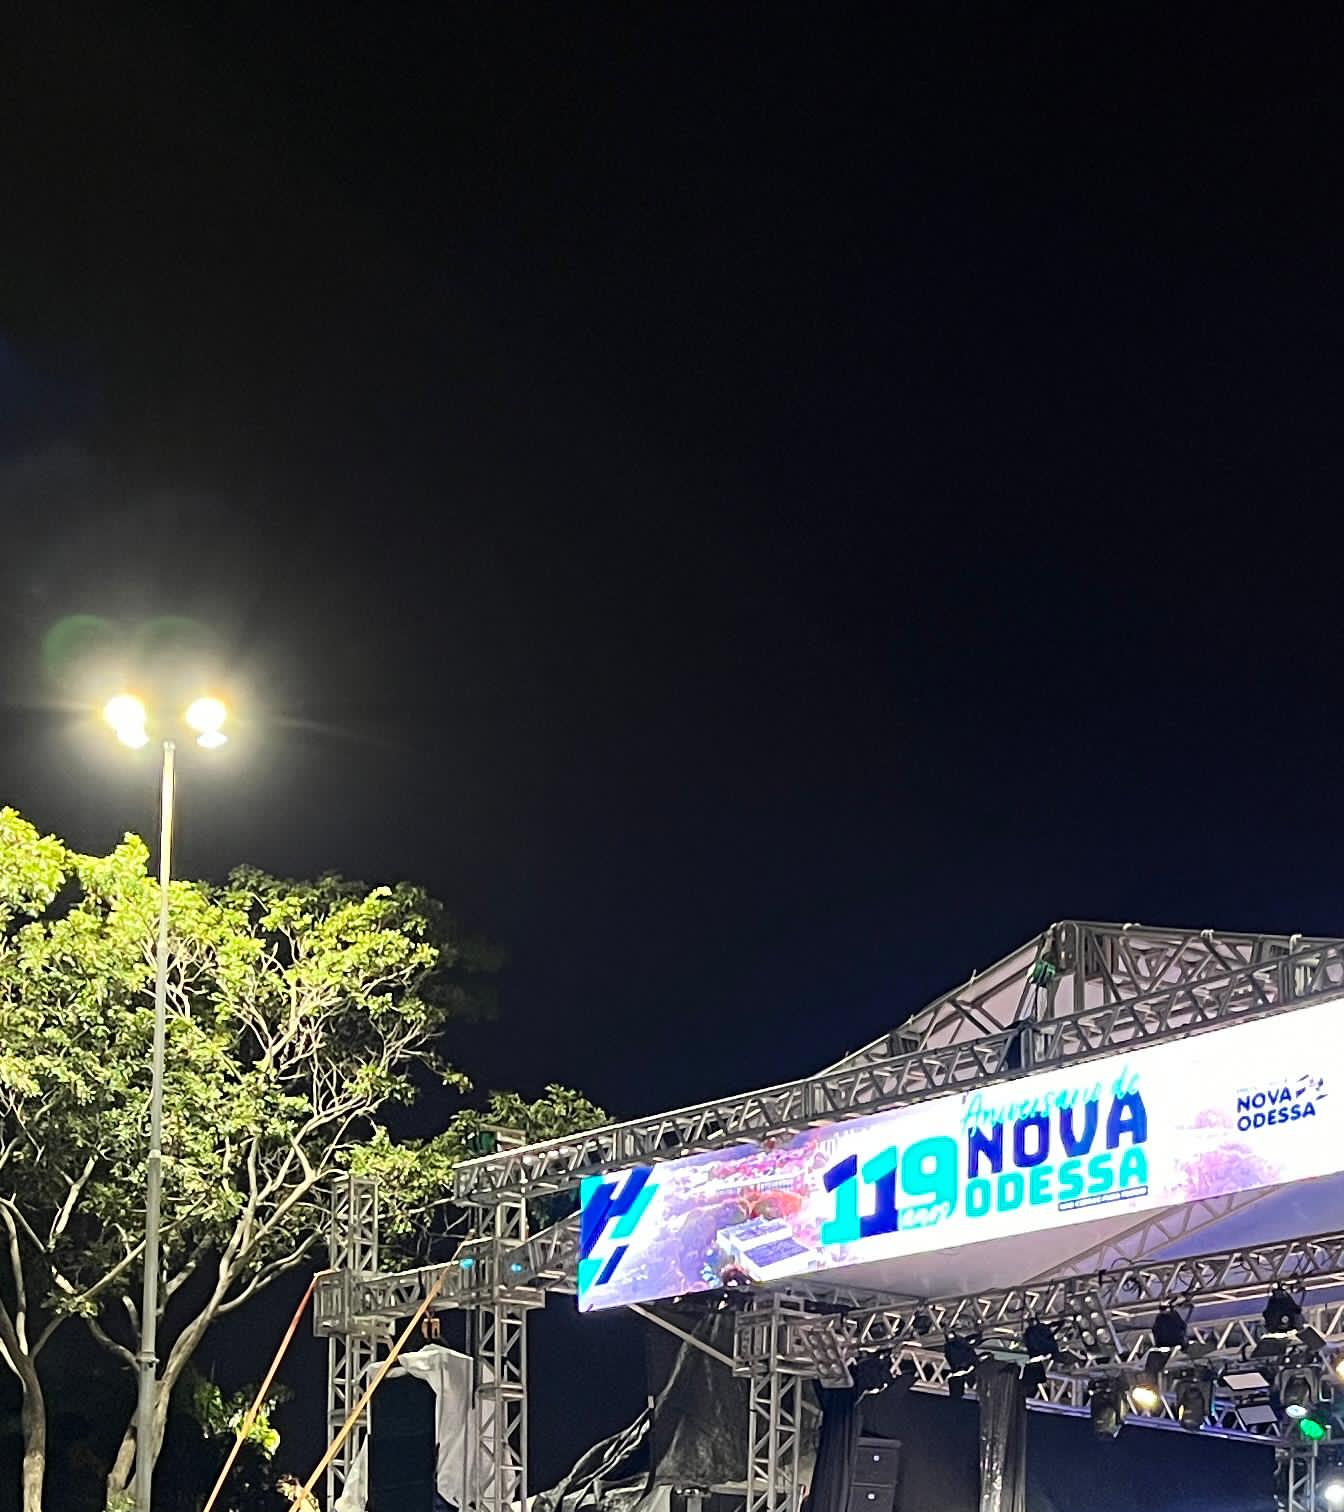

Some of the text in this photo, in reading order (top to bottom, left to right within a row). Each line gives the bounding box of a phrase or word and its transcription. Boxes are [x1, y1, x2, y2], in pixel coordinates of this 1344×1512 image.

[968, 1091, 1147, 1179] NOVA
[1237, 1087, 1291, 1113] NOVA
[1237, 1102, 1316, 1131] ODESSA
[821, 1136, 958, 1244] 119
[965, 1147, 1148, 1218] ODESSA
